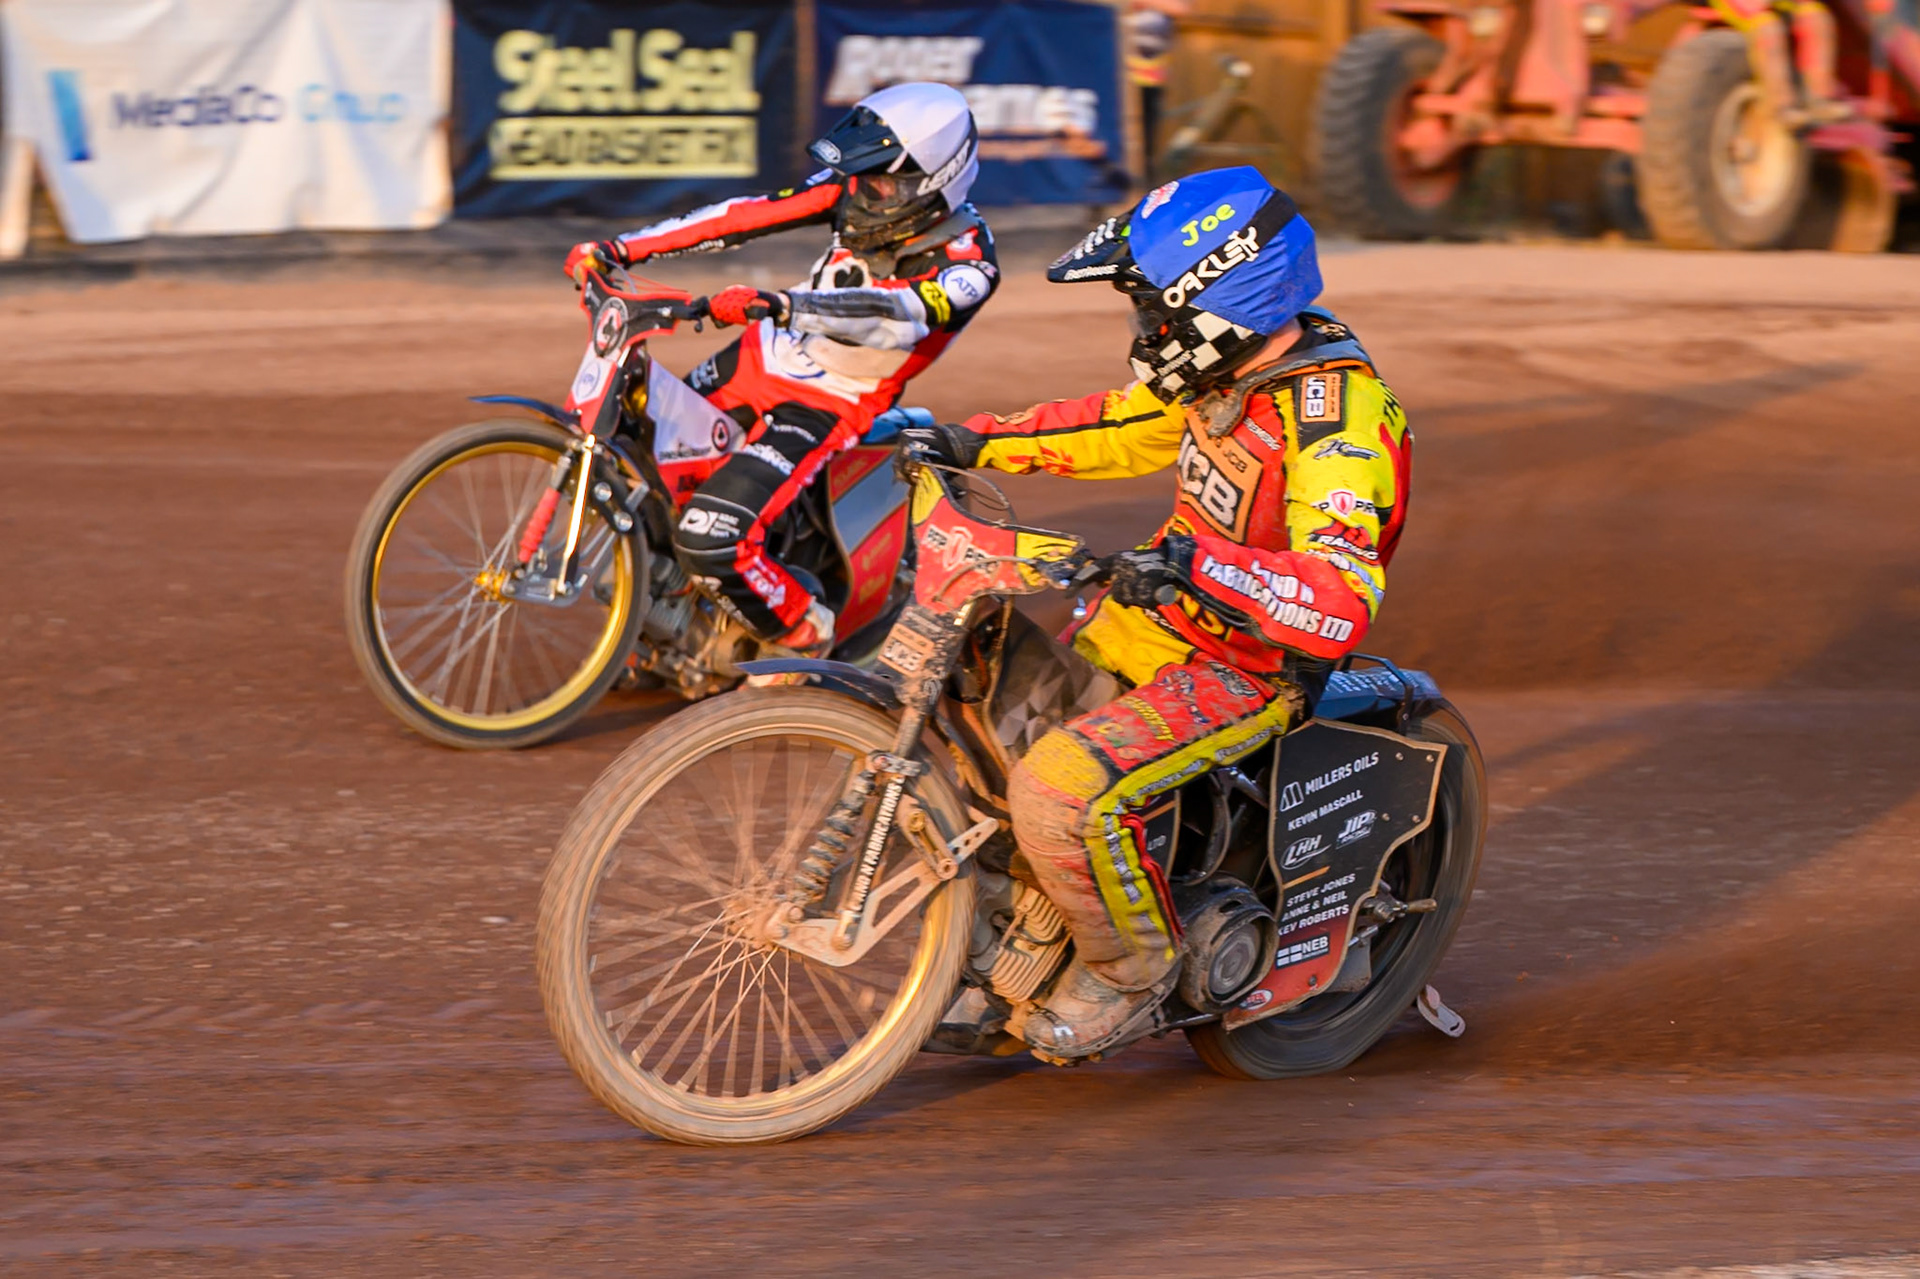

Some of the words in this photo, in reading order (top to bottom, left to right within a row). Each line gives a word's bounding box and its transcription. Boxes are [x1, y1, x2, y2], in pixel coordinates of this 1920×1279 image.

[1181, 204, 1236, 247] Joe
[1163, 226, 1260, 309] OAKLEY
[1318, 615, 1355, 642] LTD
[1305, 763, 1353, 795] MILLERS
[1353, 751, 1380, 773] OILS
[1287, 809, 1319, 832] KEVIN
[1319, 789, 1364, 817] MASCALL
[1281, 903, 1312, 922] ANNE
[1311, 900, 1321, 910] &
[1322, 890, 1349, 906] NEIL
[1286, 886, 1321, 908] STEVE
[1321, 873, 1356, 893] JONES
[1298, 904, 1350, 928] ROBERTS
[1302, 936, 1329, 954] NEB
